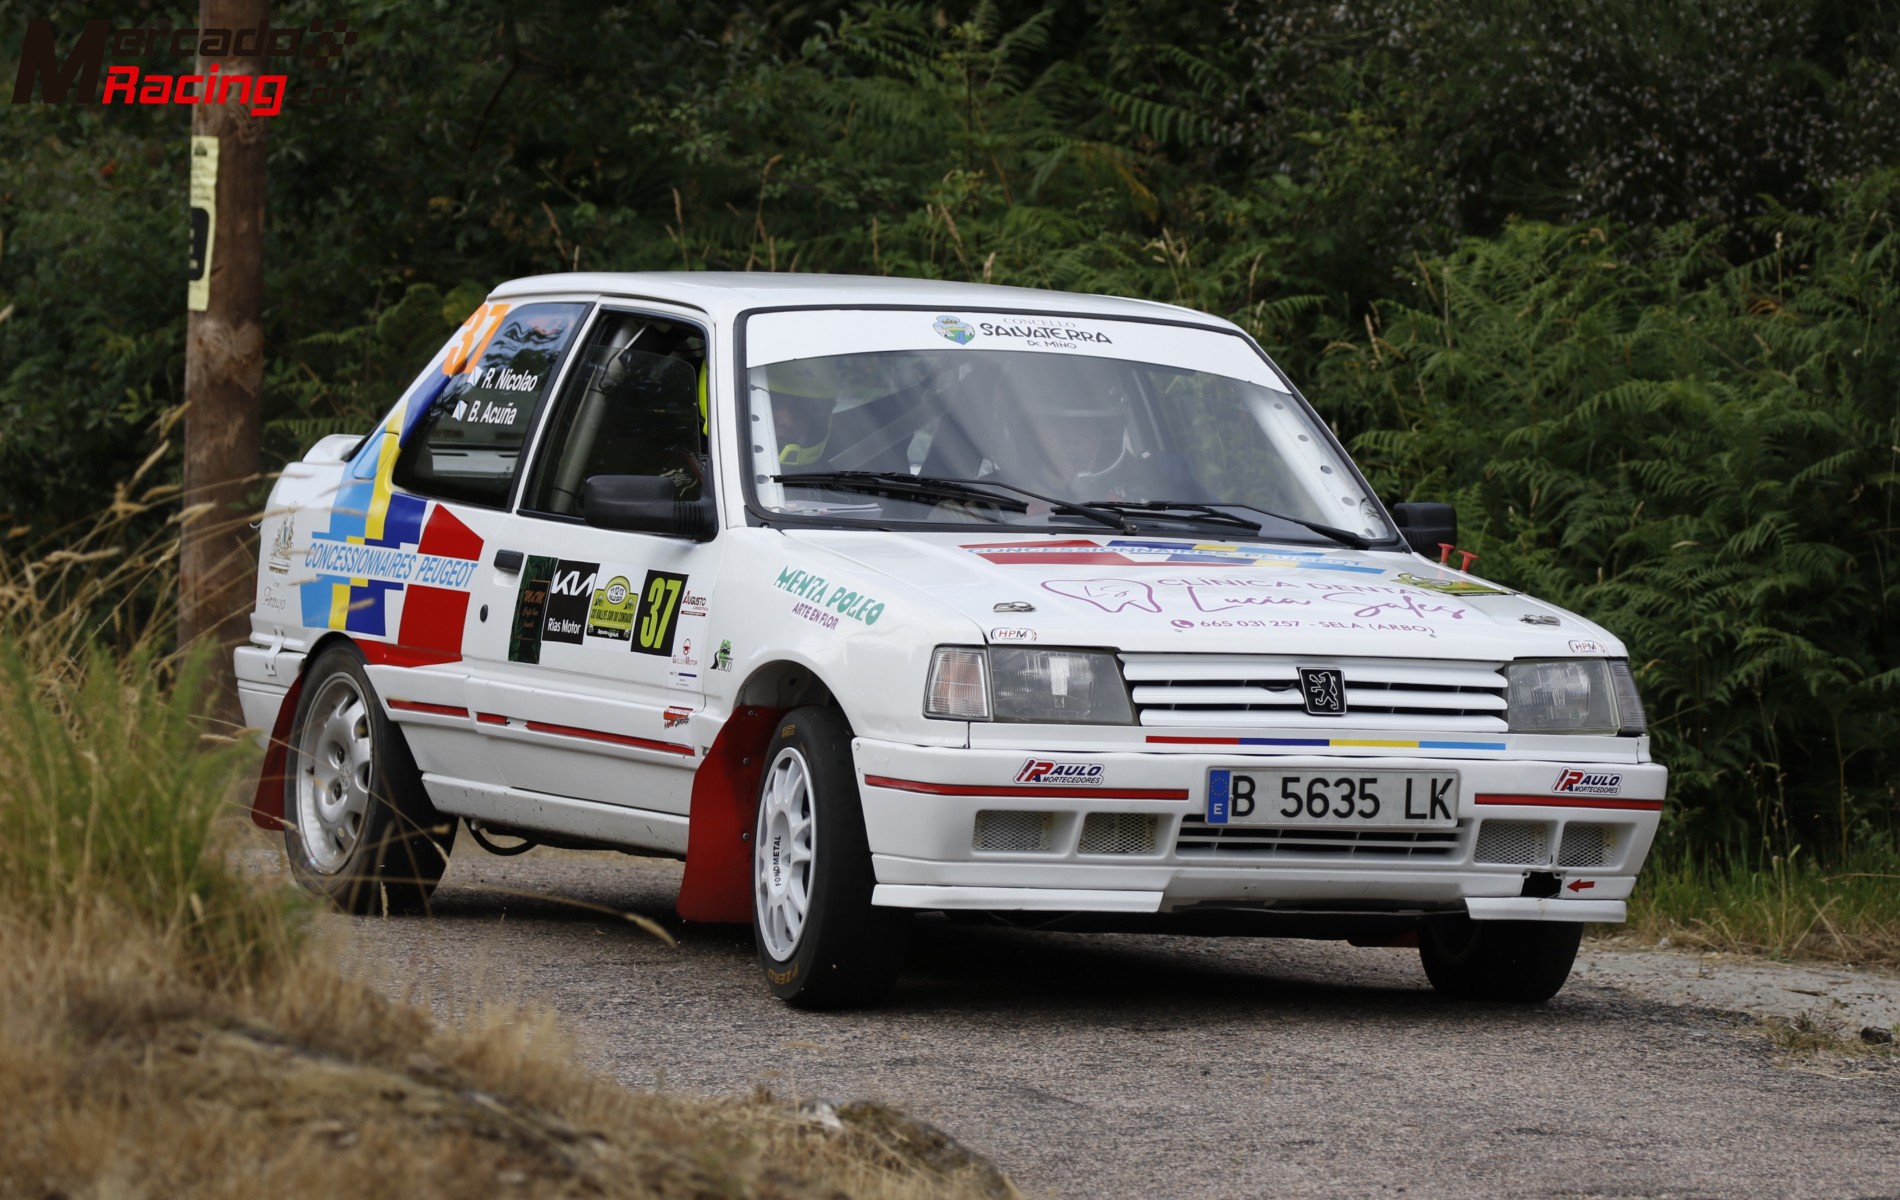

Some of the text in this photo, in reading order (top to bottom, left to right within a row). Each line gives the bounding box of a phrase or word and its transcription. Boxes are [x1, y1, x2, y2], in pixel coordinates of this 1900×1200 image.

[979, 322, 1113, 344] SALVATERRA
[1003, 317, 1076, 328] CONCELLO
[441, 302, 511, 376] 37
[481, 367, 538, 392] R. Nicolao
[467, 400, 518, 425] B. Acuña
[304, 542, 479, 588] CONCESSIONNAIRES PEUGEOT
[773, 564, 885, 625] MENTA POLEO
[1306, 583, 1444, 598] DENTAL
[640, 577, 683, 649] 37
[791, 601, 839, 631] ARTE EN FLOR
[561, 619, 581, 634] Motor
[998, 630, 1028, 638] HPM
[1319, 621, 1364, 629] SELA
[1368, 623, 1436, 634] (ARBO)
[1575, 642, 1598, 651] HPM
[1213, 803, 1223, 815] E
[1231, 775, 1454, 820] B 5635 LK
[773, 835, 782, 887] FONDMETAL
